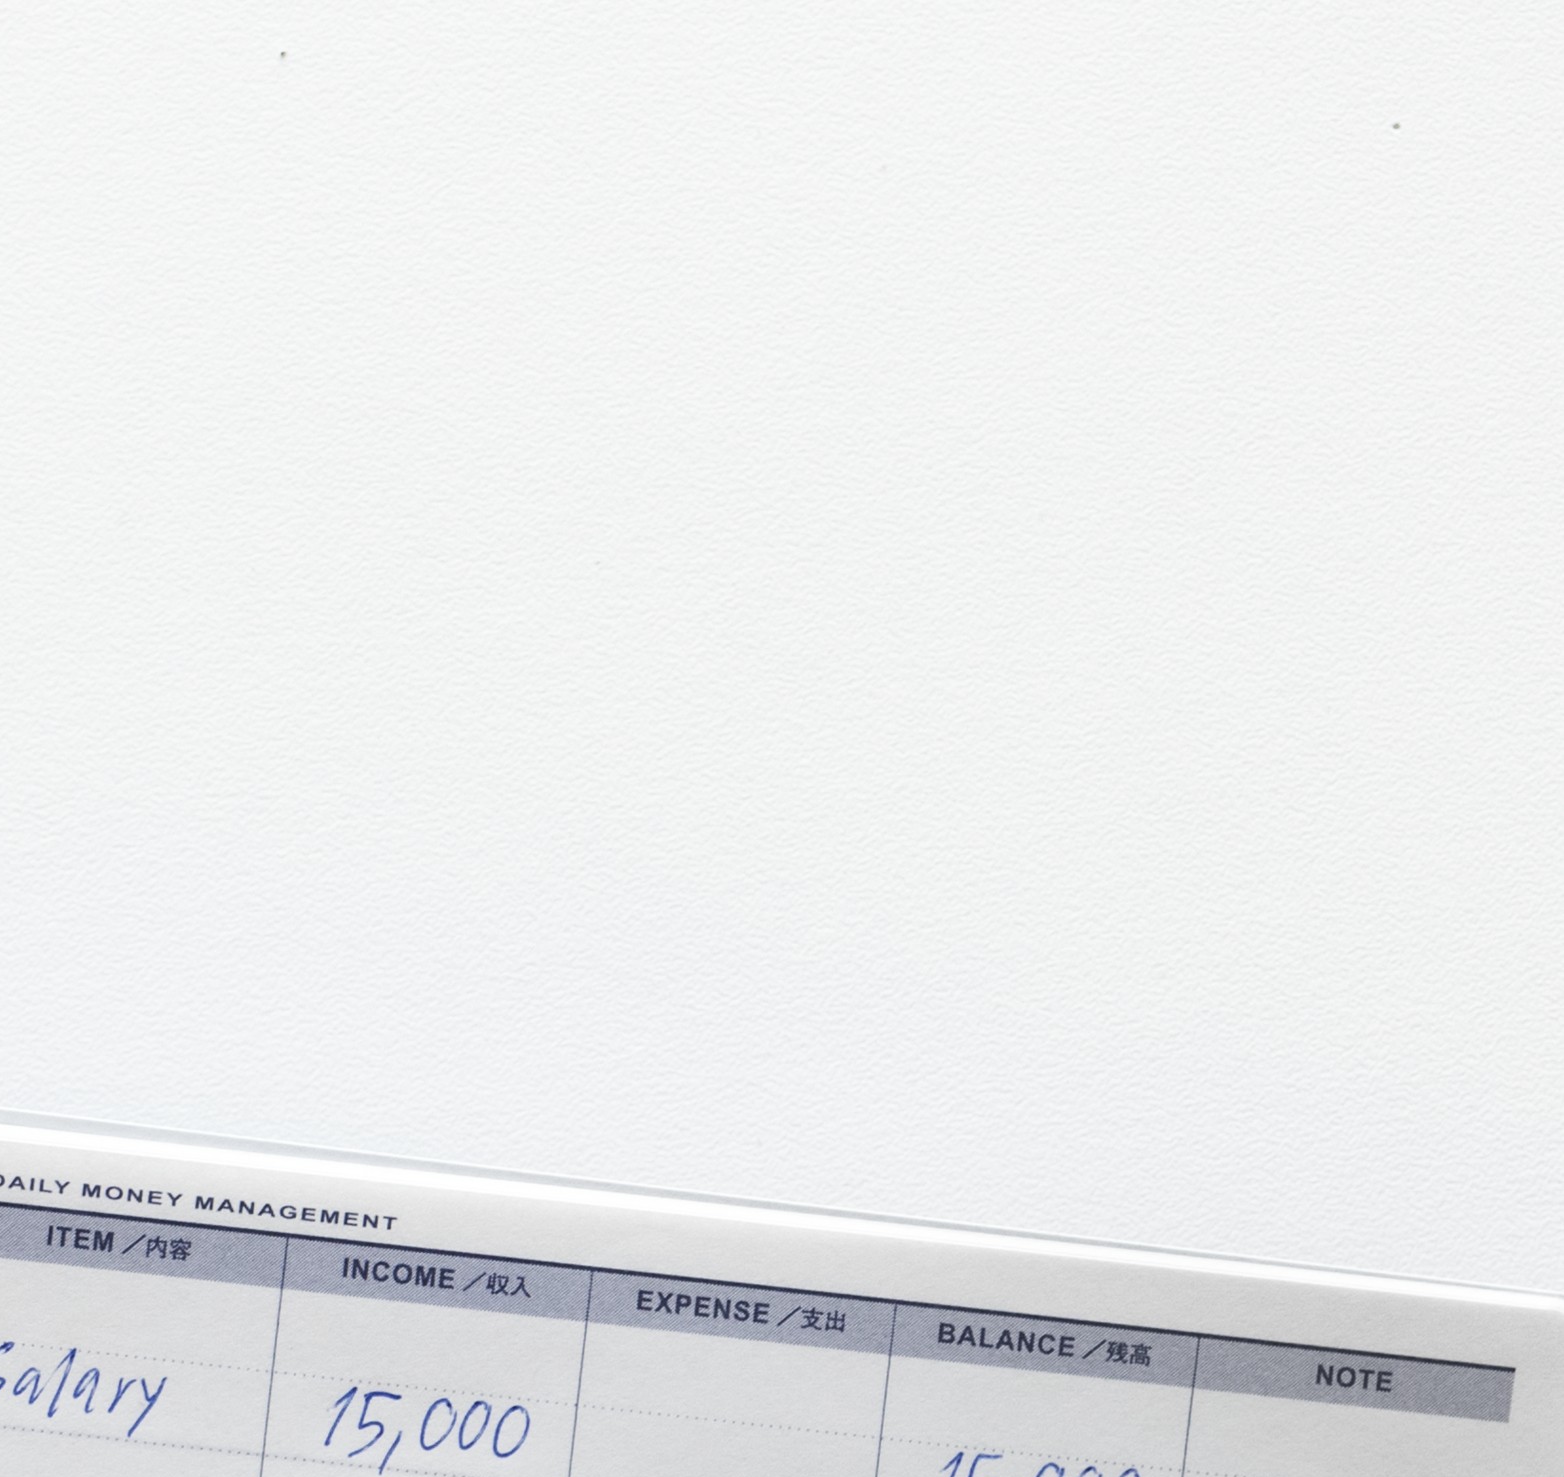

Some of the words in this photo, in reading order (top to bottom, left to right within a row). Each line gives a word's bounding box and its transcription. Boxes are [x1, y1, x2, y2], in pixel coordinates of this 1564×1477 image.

[82, 1184, 182, 1206] MONEY
[193, 1196, 399, 1231] MANAGEMENT
[46, 1224, 116, 1253] ITEM
[342, 1257, 457, 1290] INCOME
[635, 1288, 770, 1326] EXPENSE
[937, 1322, 1076, 1358] BALANCE
[1314, 1363, 1394, 1394] NOTE
[324, 1387, 530, 1472] 15,000
